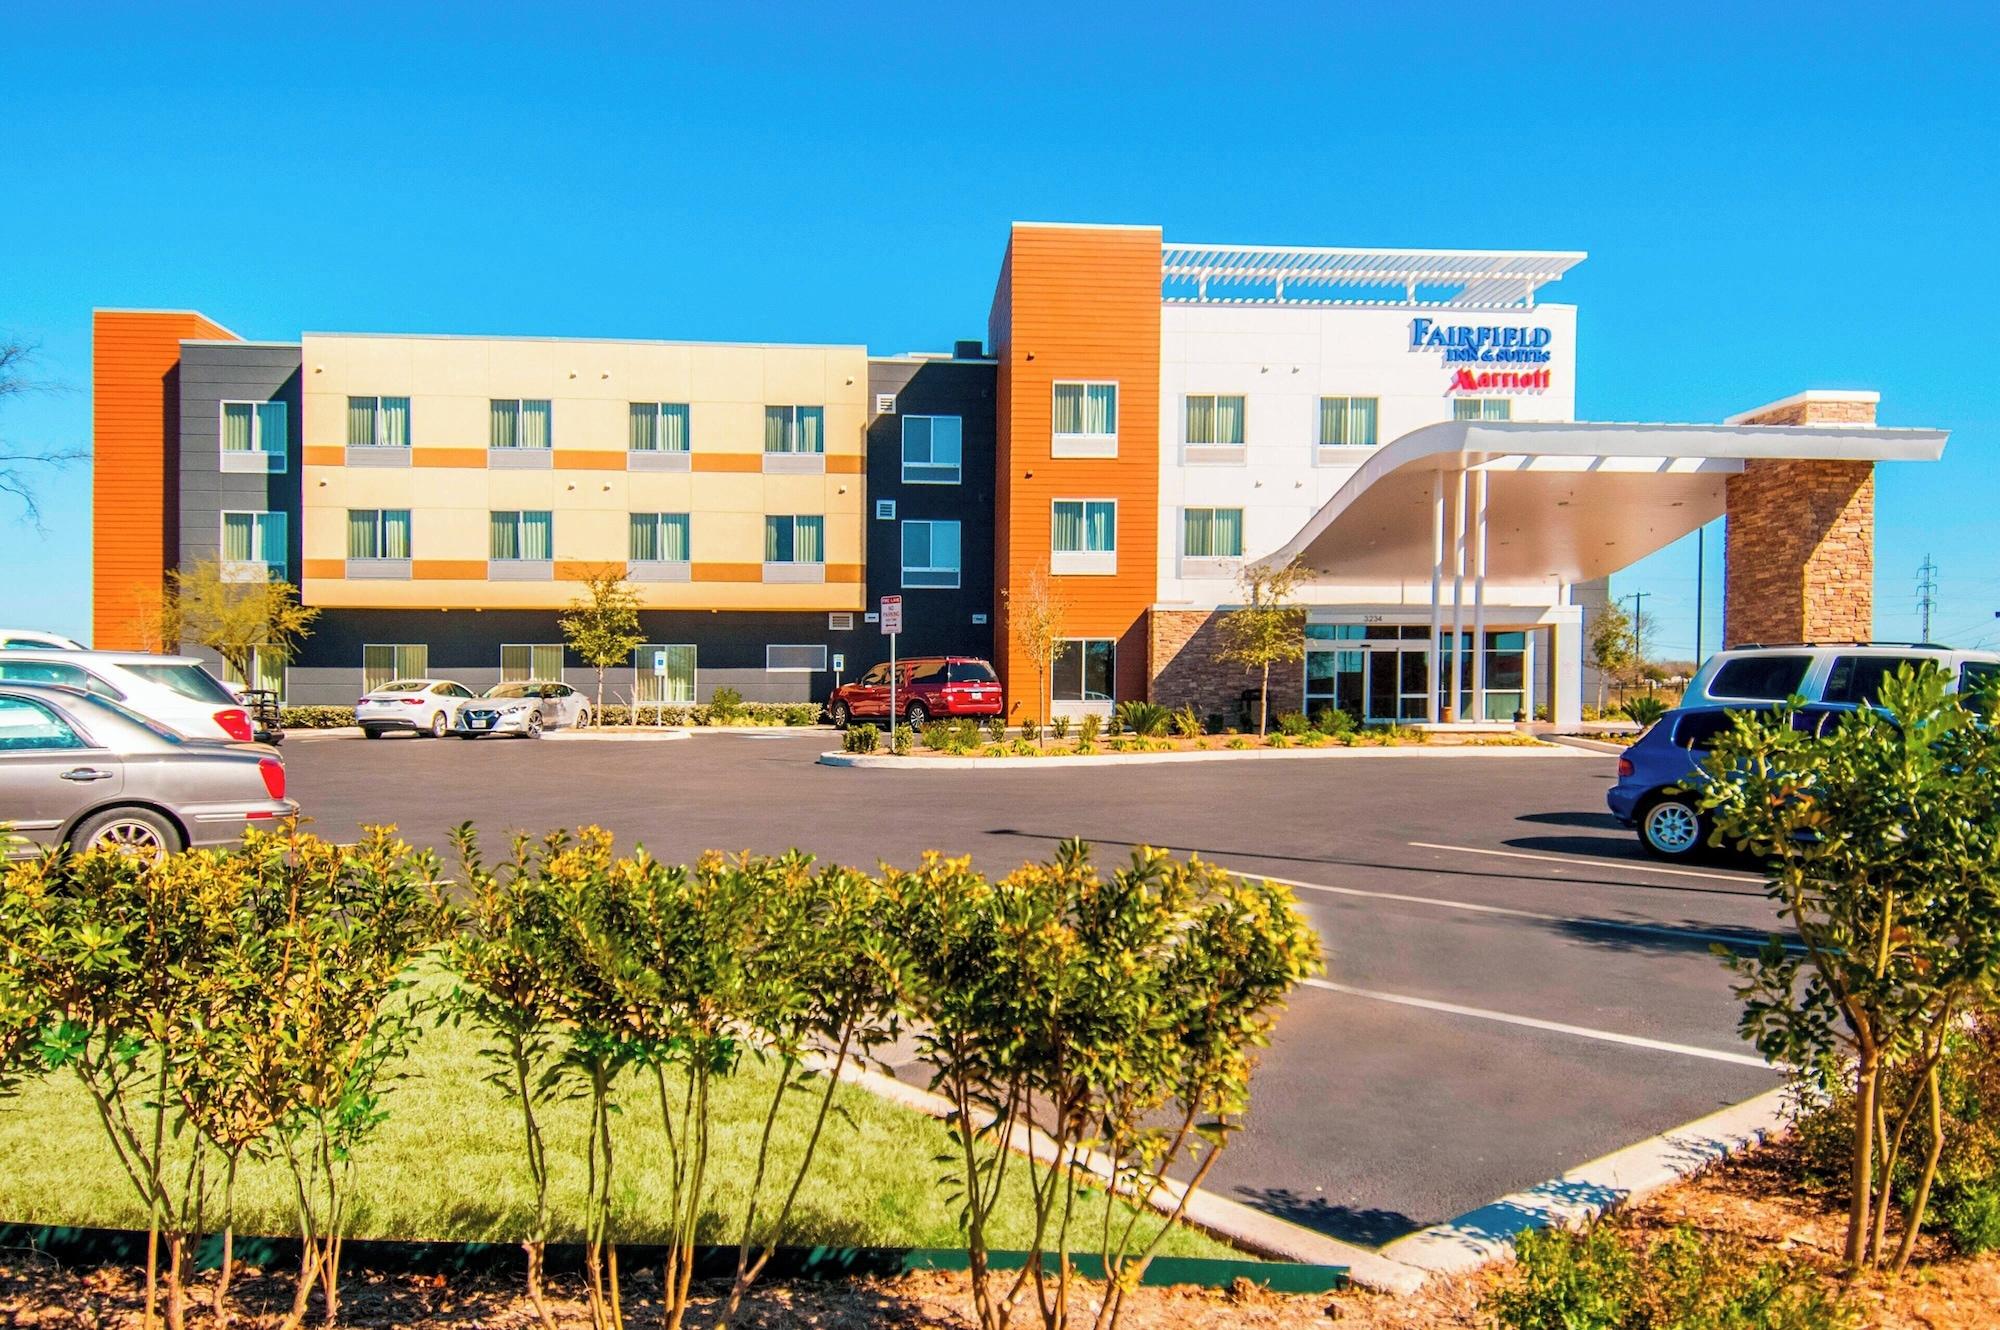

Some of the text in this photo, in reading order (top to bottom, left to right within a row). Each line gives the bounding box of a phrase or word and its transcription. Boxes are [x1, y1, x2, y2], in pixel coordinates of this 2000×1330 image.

[1413, 318, 1552, 350] FAIRFIELD
[1446, 349, 1551, 363] INN & SUITES
[1448, 368, 1551, 391] Marriott
[1364, 615, 1383, 623] 3234
